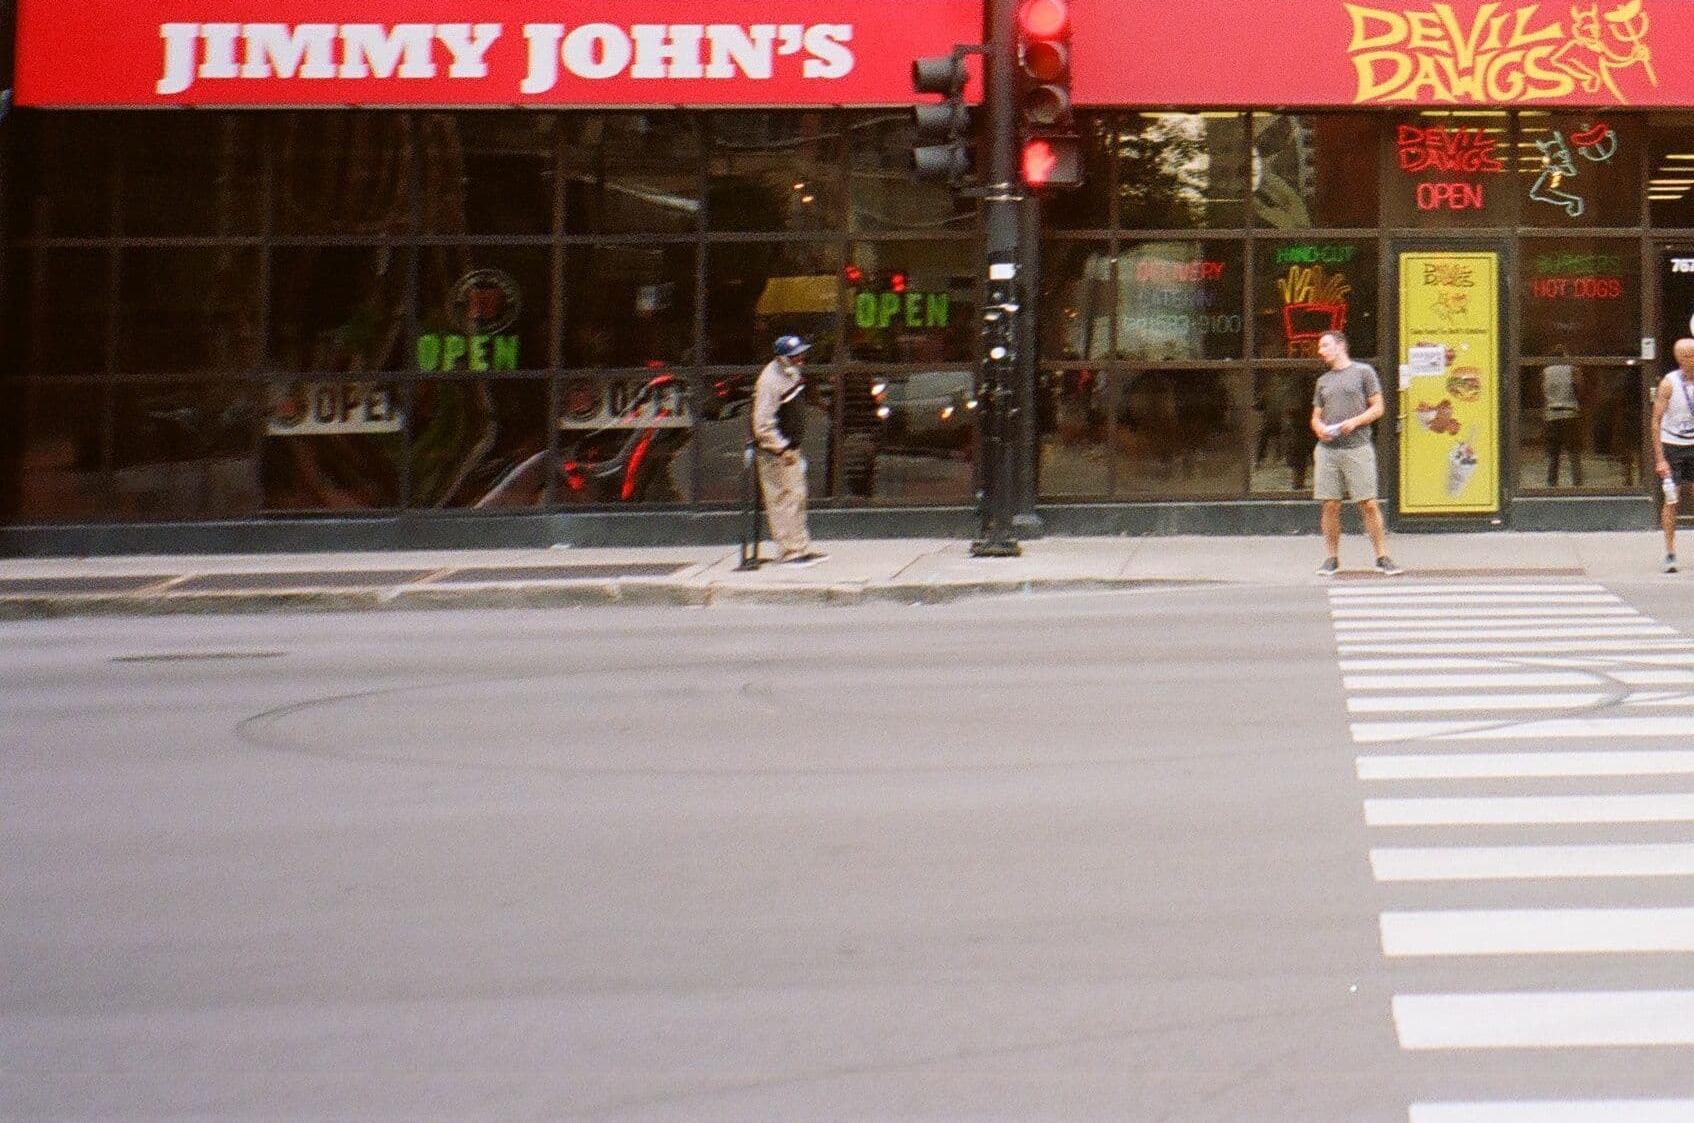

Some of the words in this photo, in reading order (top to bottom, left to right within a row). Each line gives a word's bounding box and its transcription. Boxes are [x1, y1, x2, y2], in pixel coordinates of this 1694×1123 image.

[1343, 1, 1564, 68] DEVIL
[155, 22, 502, 95] JIMMY
[519, 22, 855, 95] JOHN'S
[1352, 45, 1576, 105] DAWGS
[1397, 123, 1497, 155] DEVIL
[1399, 146, 1504, 174] DAWGS
[1416, 182, 1484, 210] OPEN
[1532, 278, 1569, 298] HOT
[1573, 277, 1622, 298] DOGS
[855, 291, 949, 328] OPEN
[416, 333, 520, 372] OPEN
